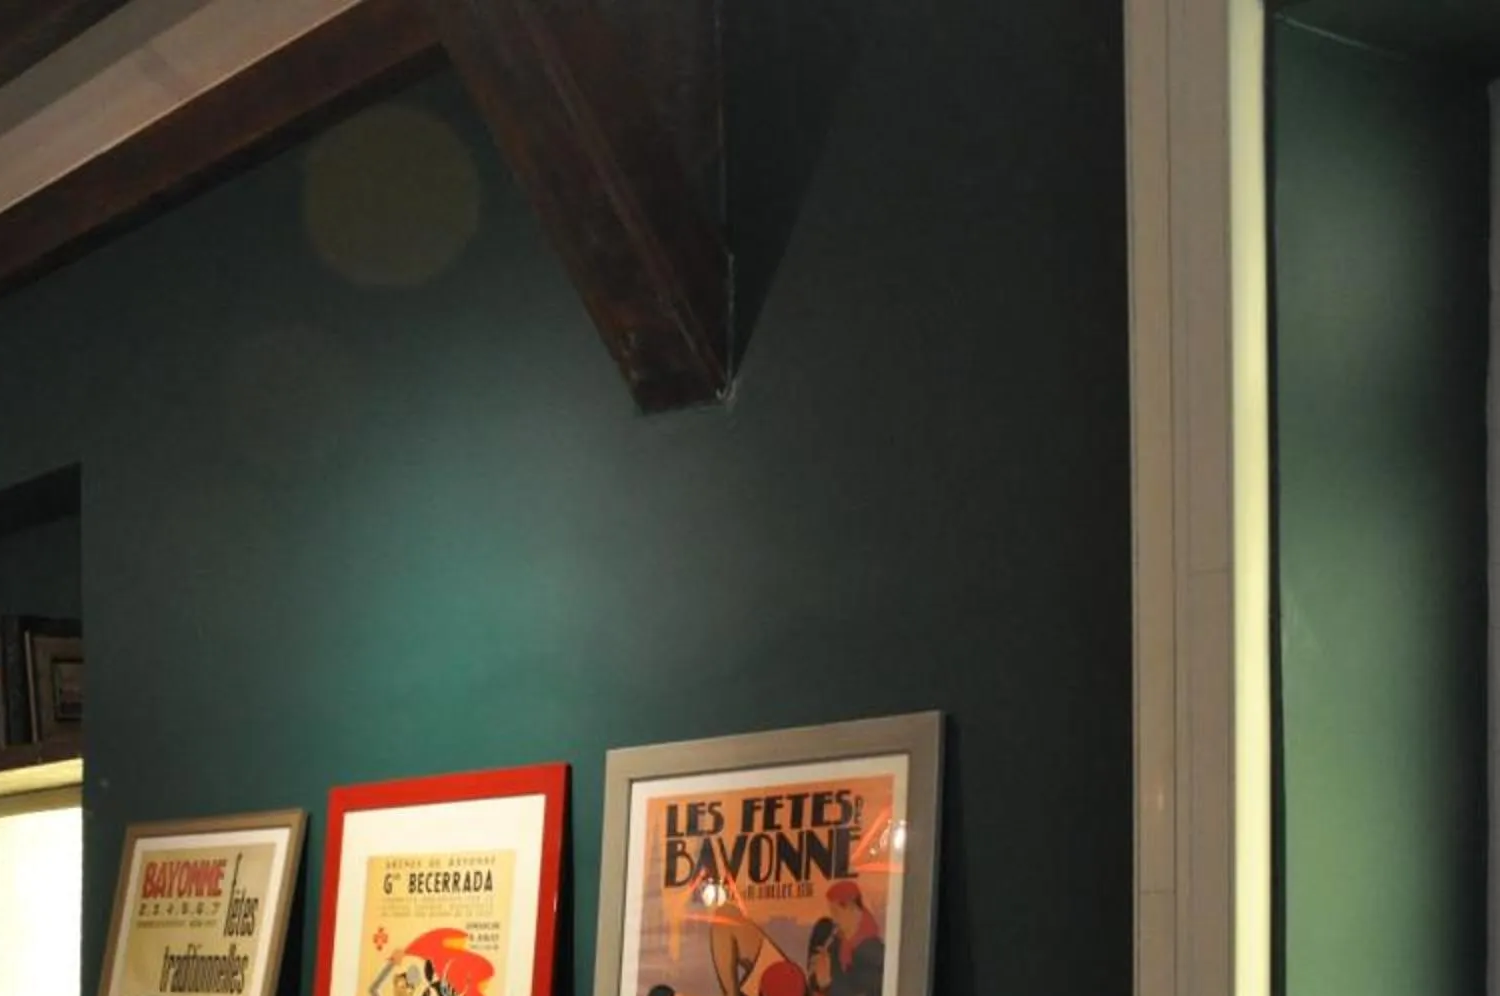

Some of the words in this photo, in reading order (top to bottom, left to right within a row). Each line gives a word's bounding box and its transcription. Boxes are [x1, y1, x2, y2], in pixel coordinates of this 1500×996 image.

[665, 800, 726, 838] LES
[664, 826, 862, 889] BAYONNE
[141, 857, 228, 899] BAYONNE
[408, 867, 495, 895] BECERRADA
